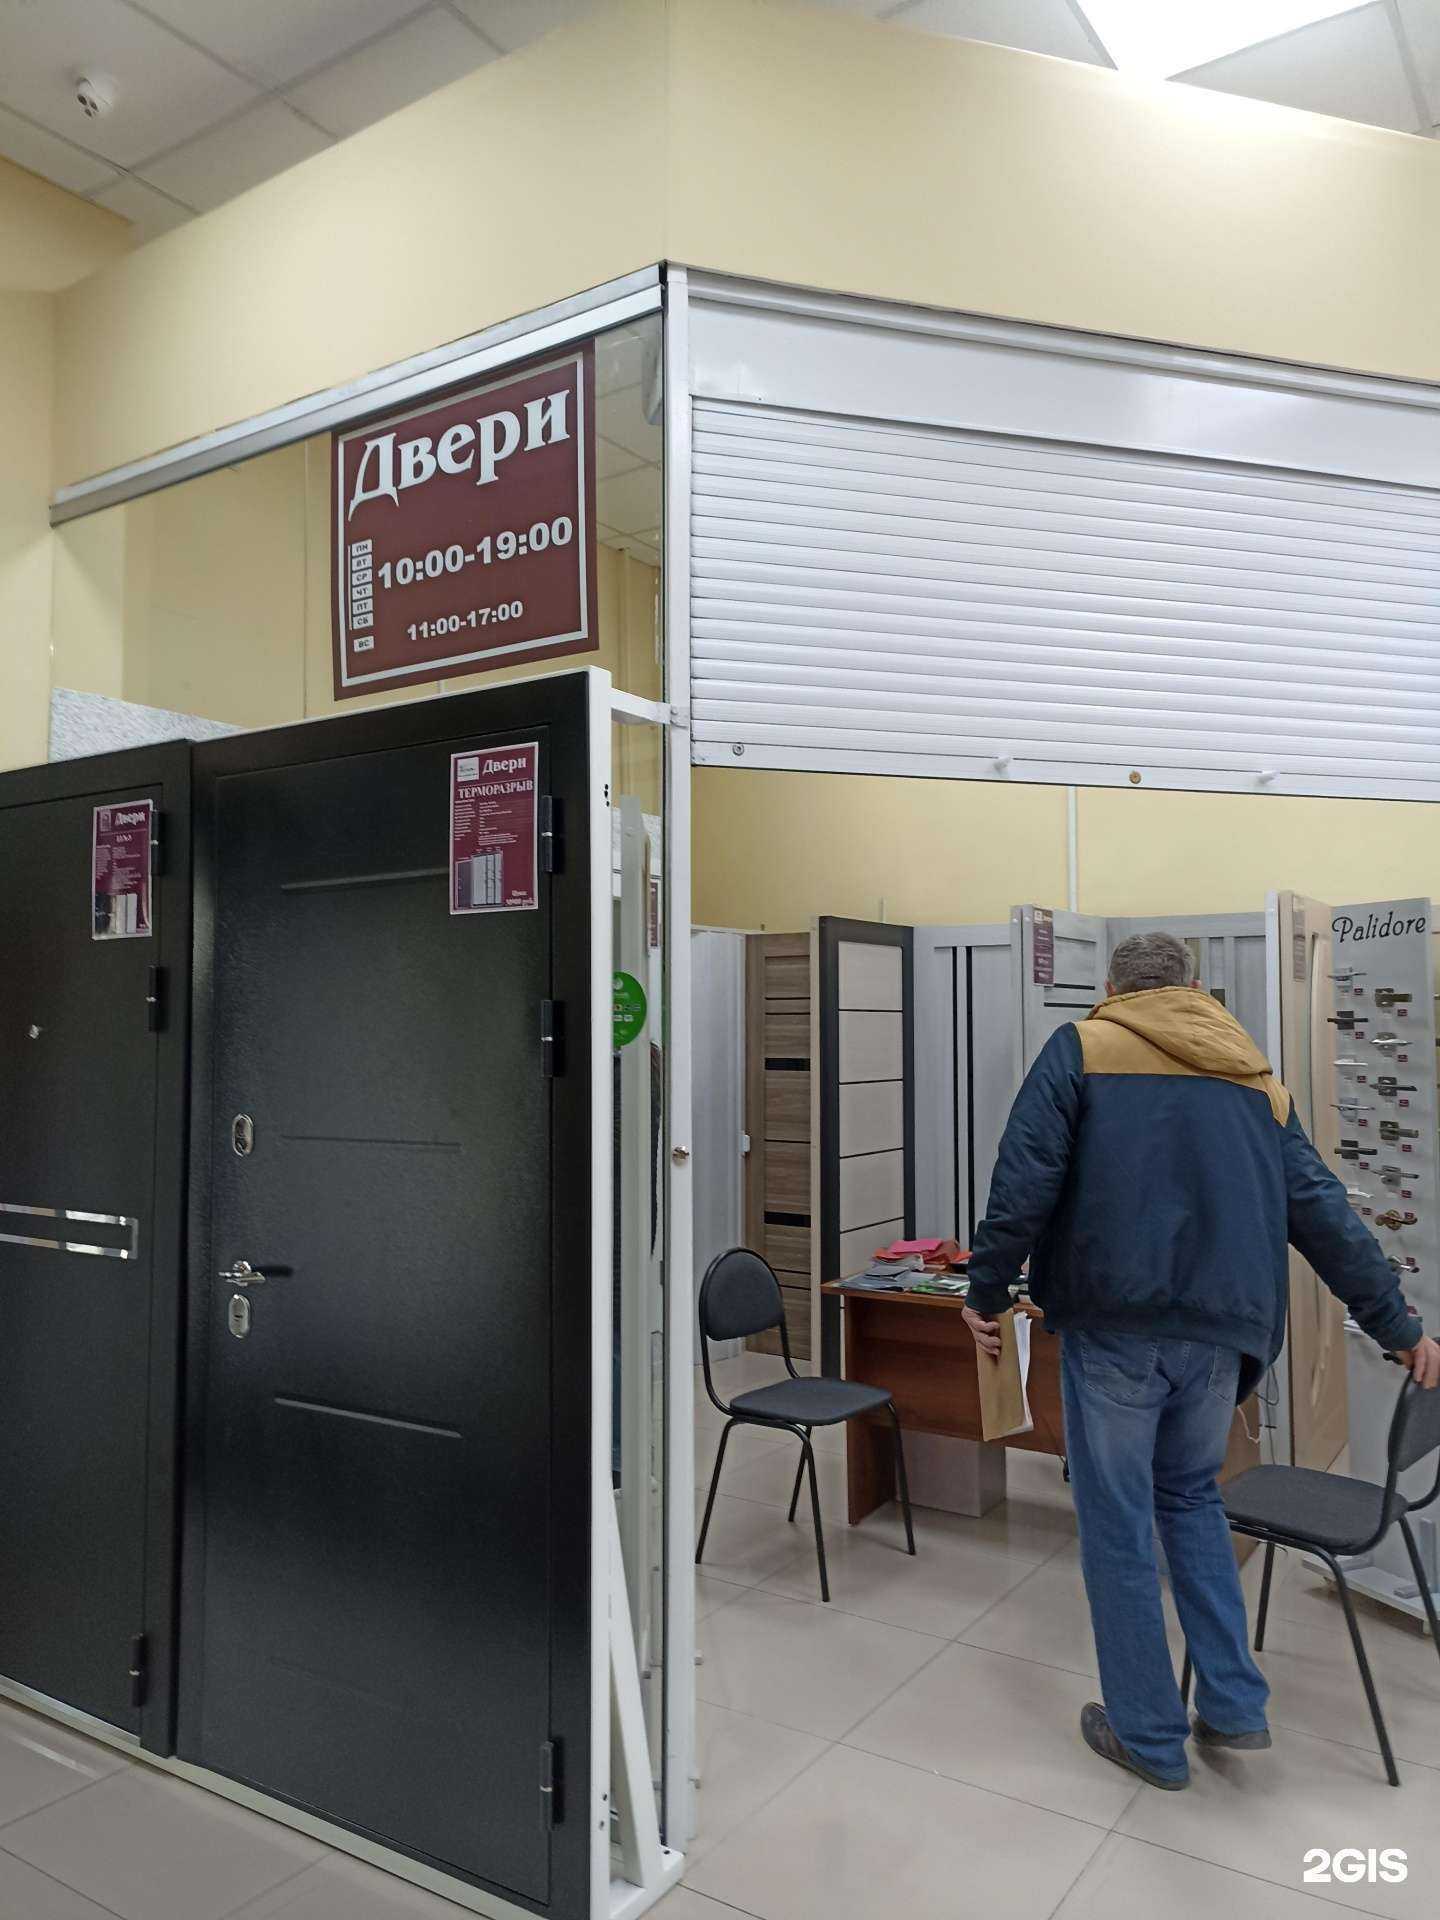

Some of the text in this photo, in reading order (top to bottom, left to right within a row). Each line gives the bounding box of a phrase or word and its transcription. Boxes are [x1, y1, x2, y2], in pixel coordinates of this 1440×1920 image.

[348, 389, 570, 522] Двери
[378, 516, 573, 589] 10:00-19:00
[406, 600, 524, 641] 11:00-17:00
[482, 757, 527, 776] Двери
[458, 780, 533, 799] ТЕРМОРАЗРЫВ
[1331, 911, 1426, 943] Palidore
